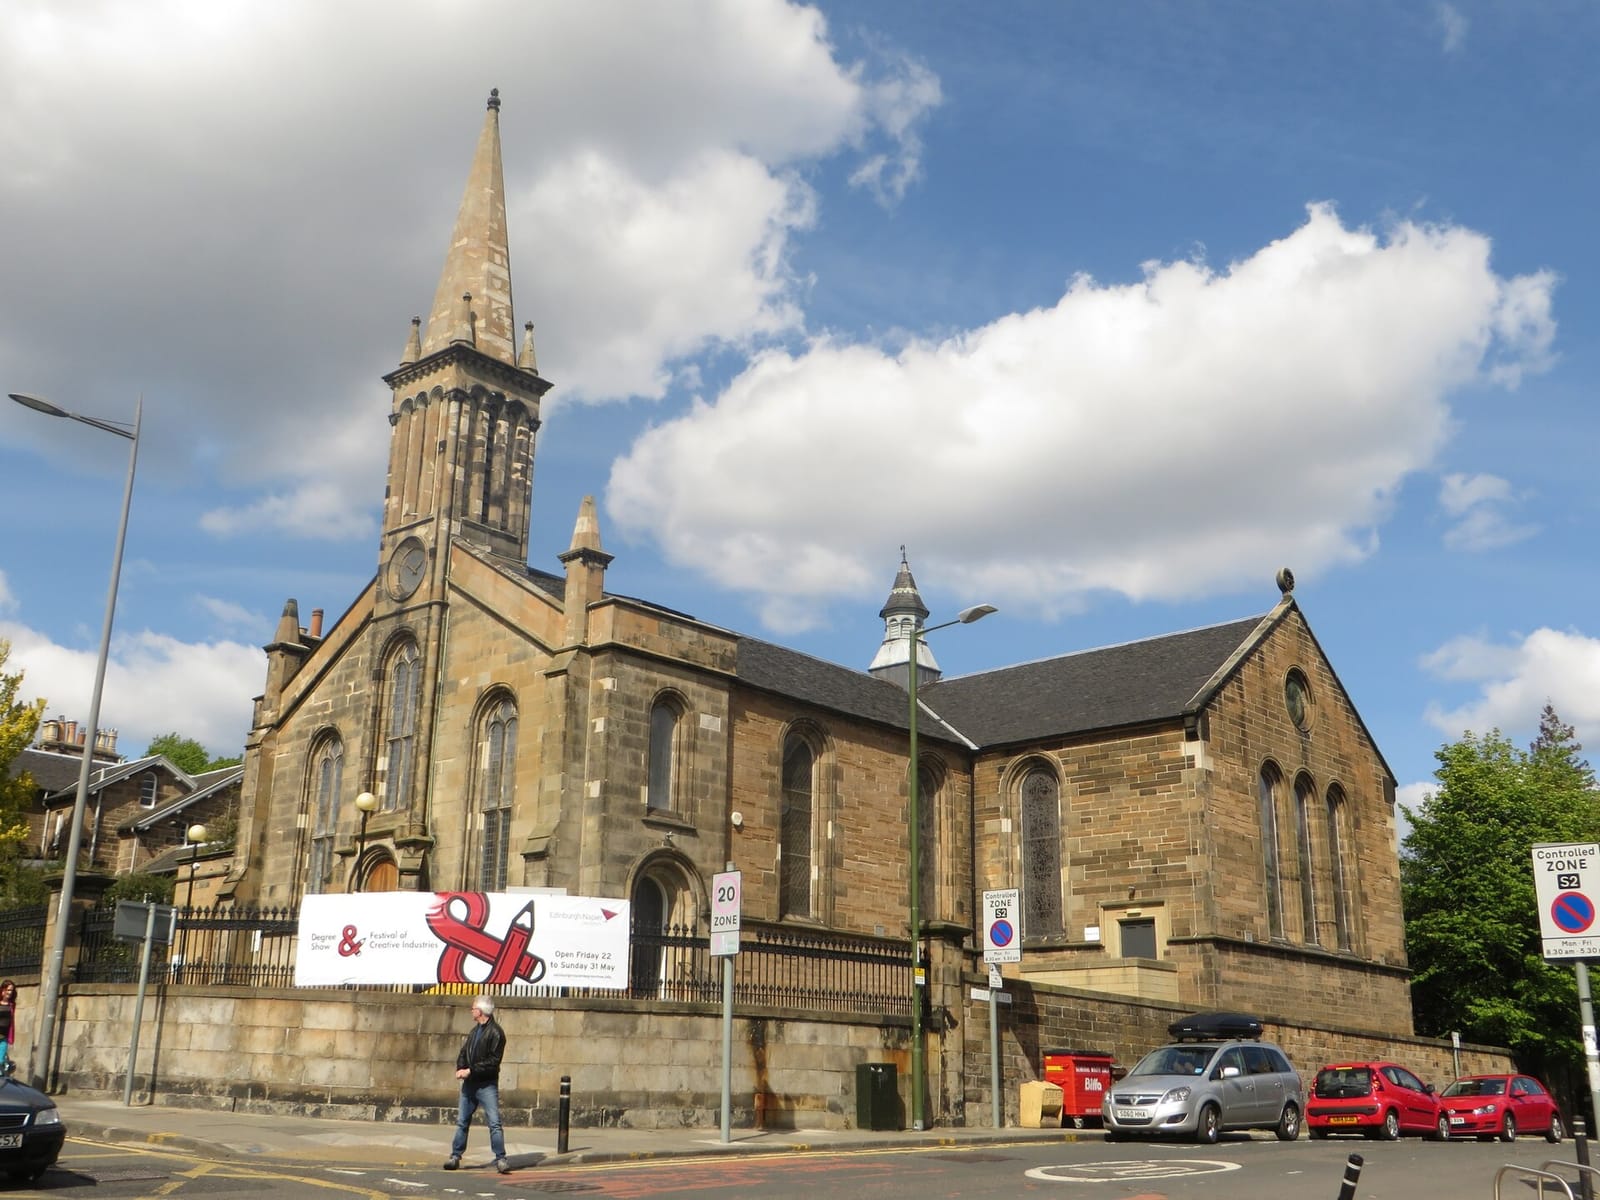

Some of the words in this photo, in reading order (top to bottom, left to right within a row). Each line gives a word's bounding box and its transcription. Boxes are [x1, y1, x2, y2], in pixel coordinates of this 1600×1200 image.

[1537, 847, 1595, 859] Controlled
[1547, 859, 1587, 871] ZONE
[1560, 876, 1578, 887] S2
[718, 886, 735, 902] 20
[996, 909, 1006, 917] S2
[714, 915, 737, 926] ZONE
[311, 933, 337, 943] Degree
[370, 930, 398, 939] Festival
[400, 930, 408, 939] of
[369, 941, 400, 949] Creative
[402, 941, 438, 949] Industries
[555, 950, 574, 959] Open
[577, 951, 599, 960] Friday
[561, 962, 588, 971] Sunday
[600, 963, 615, 972] May
[1084, 1077, 1102, 1091] Biffa
